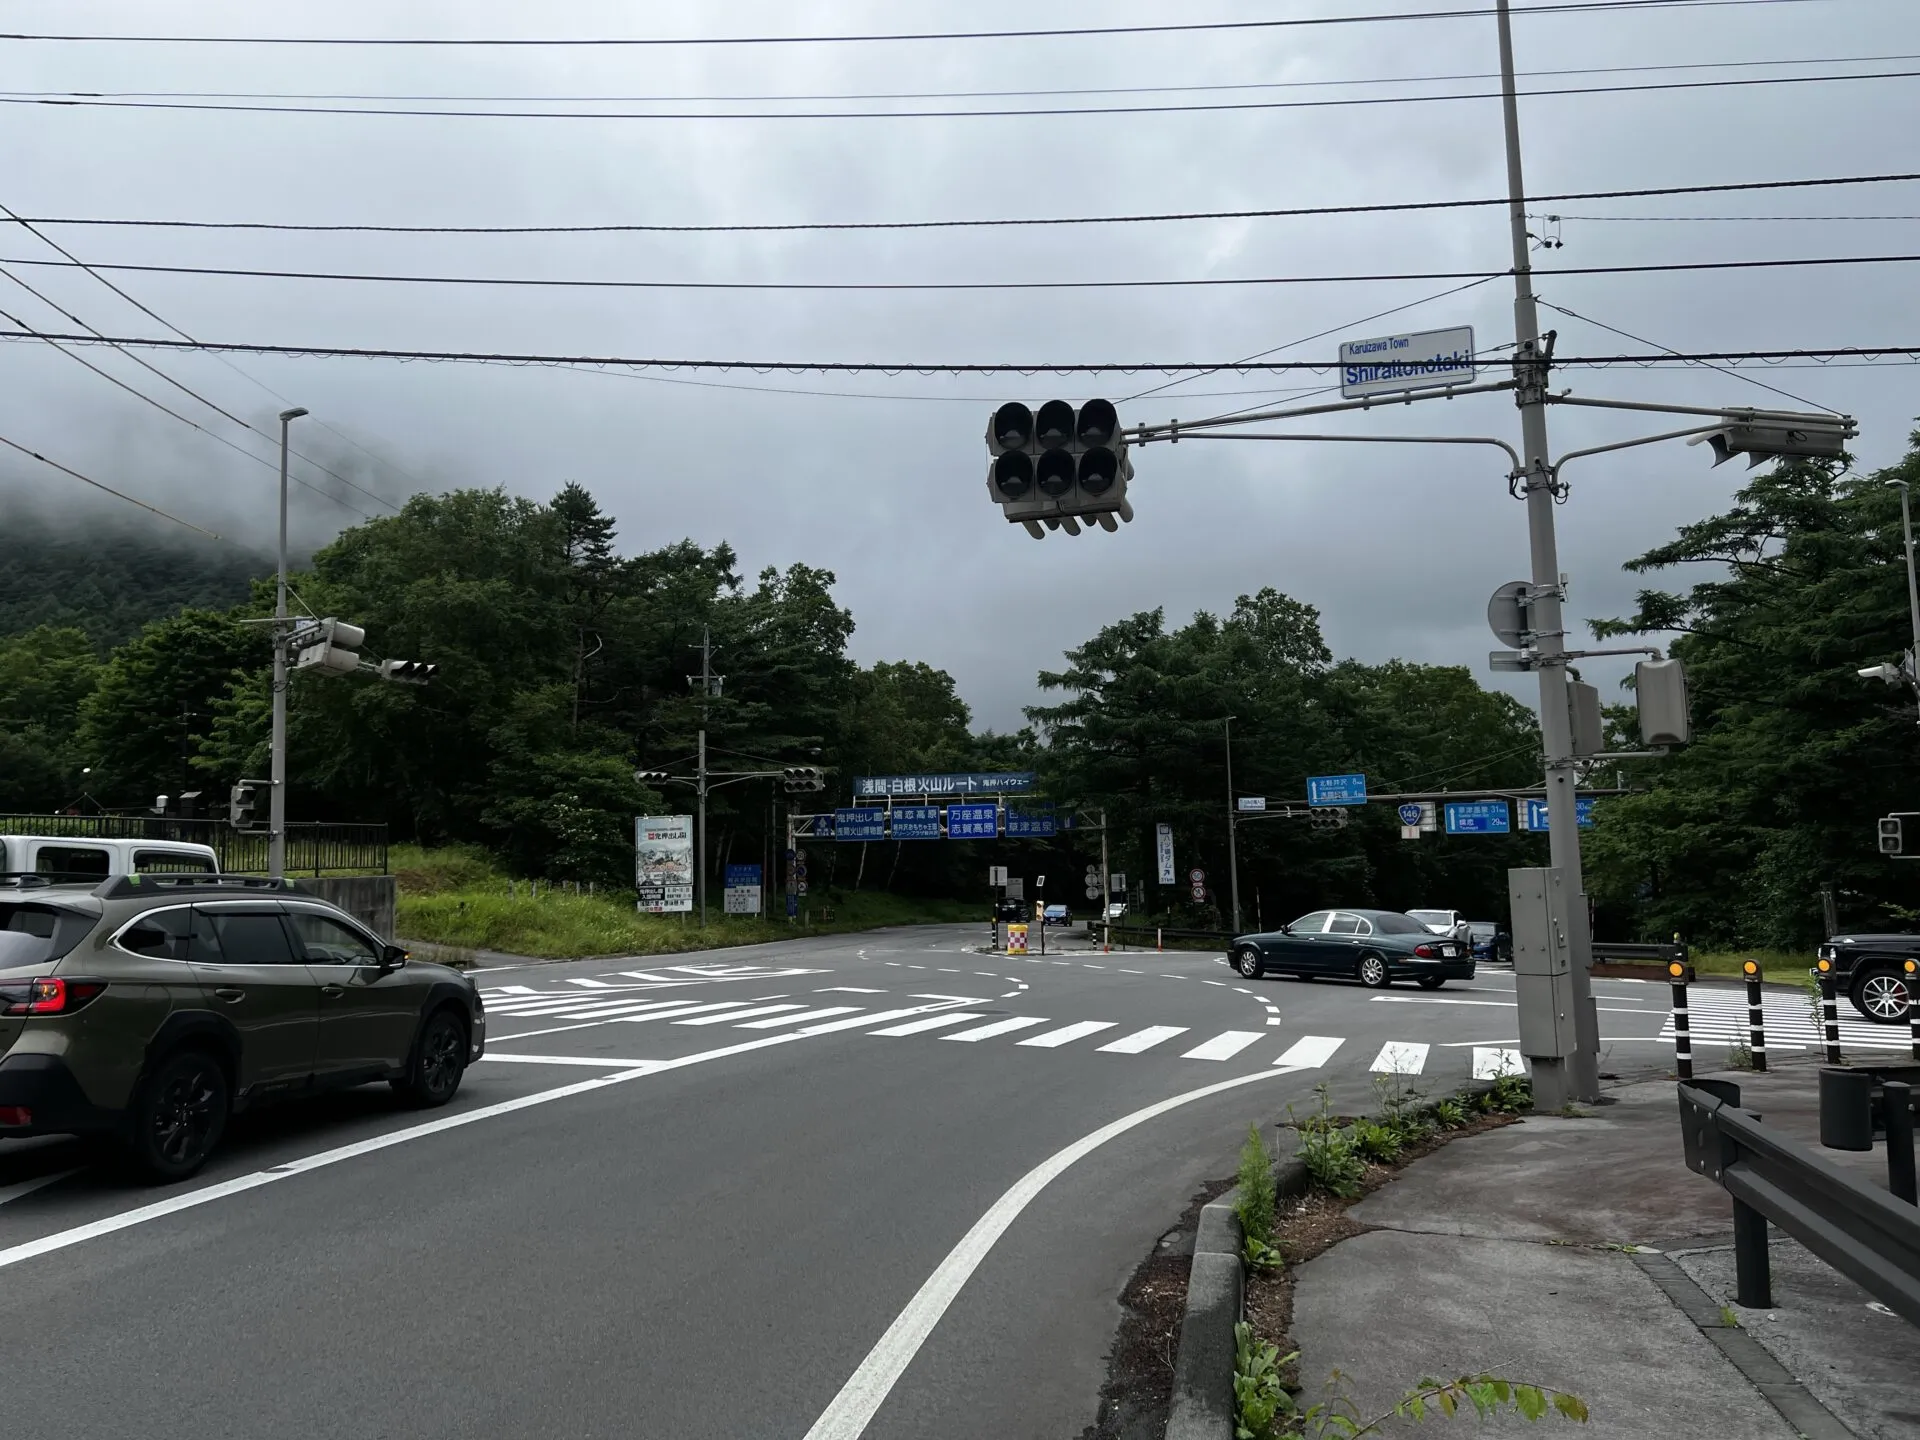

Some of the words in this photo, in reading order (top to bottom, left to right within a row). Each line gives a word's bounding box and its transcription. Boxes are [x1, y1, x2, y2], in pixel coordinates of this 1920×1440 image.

[1349, 340, 1388, 356] Karuizawa
[1389, 337, 1409, 351] Town
[1346, 349, 1471, 385] Shiraitonotaki
[837, 812, 882, 823] 鬼押出し園
[893, 809, 937, 820] 嬬恋高原
[951, 809, 993, 820] 万座温泉
[1402, 809, 1418, 818] 146
[951, 822, 993, 834] 志賀高原
[1009, 821, 1052, 832] 草津温泉
